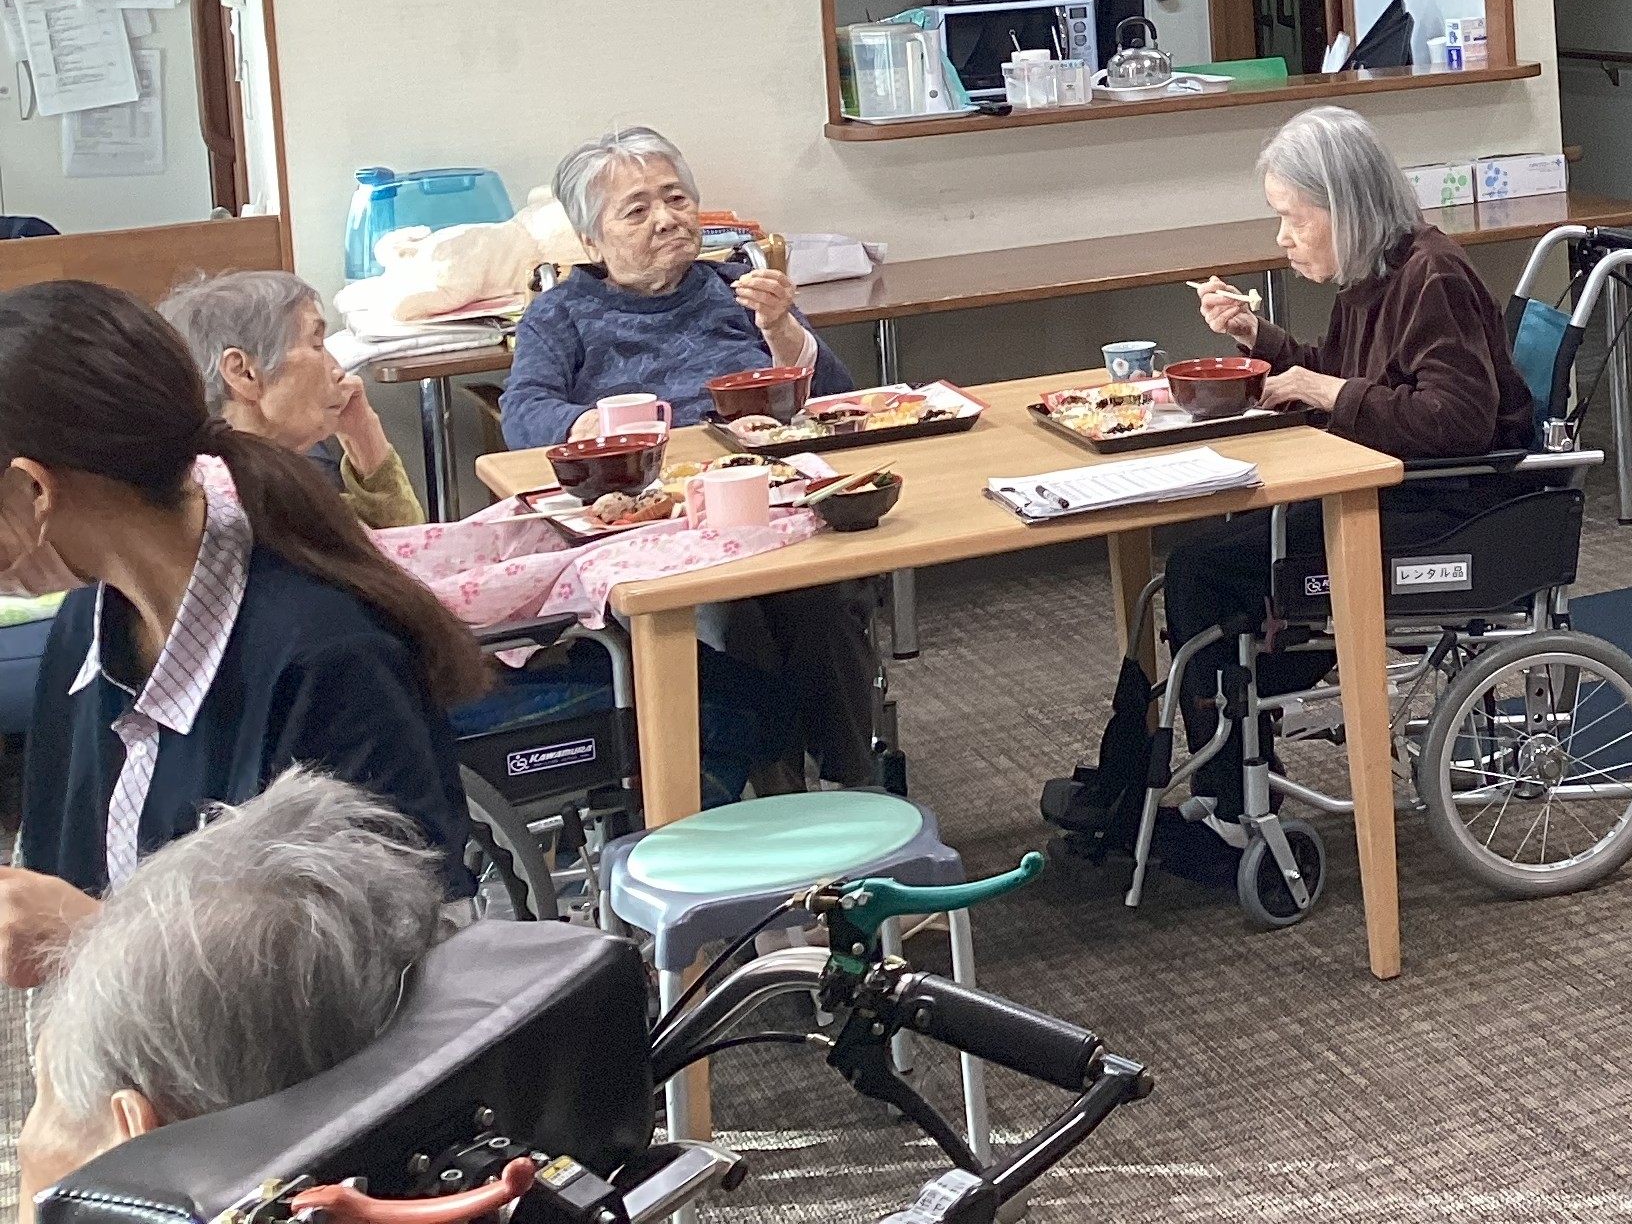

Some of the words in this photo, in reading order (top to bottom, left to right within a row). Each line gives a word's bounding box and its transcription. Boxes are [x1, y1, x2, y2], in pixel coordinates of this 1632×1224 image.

[1400, 565, 1465, 581] レンタル品
[528, 744, 594, 764] KAWAMURA
